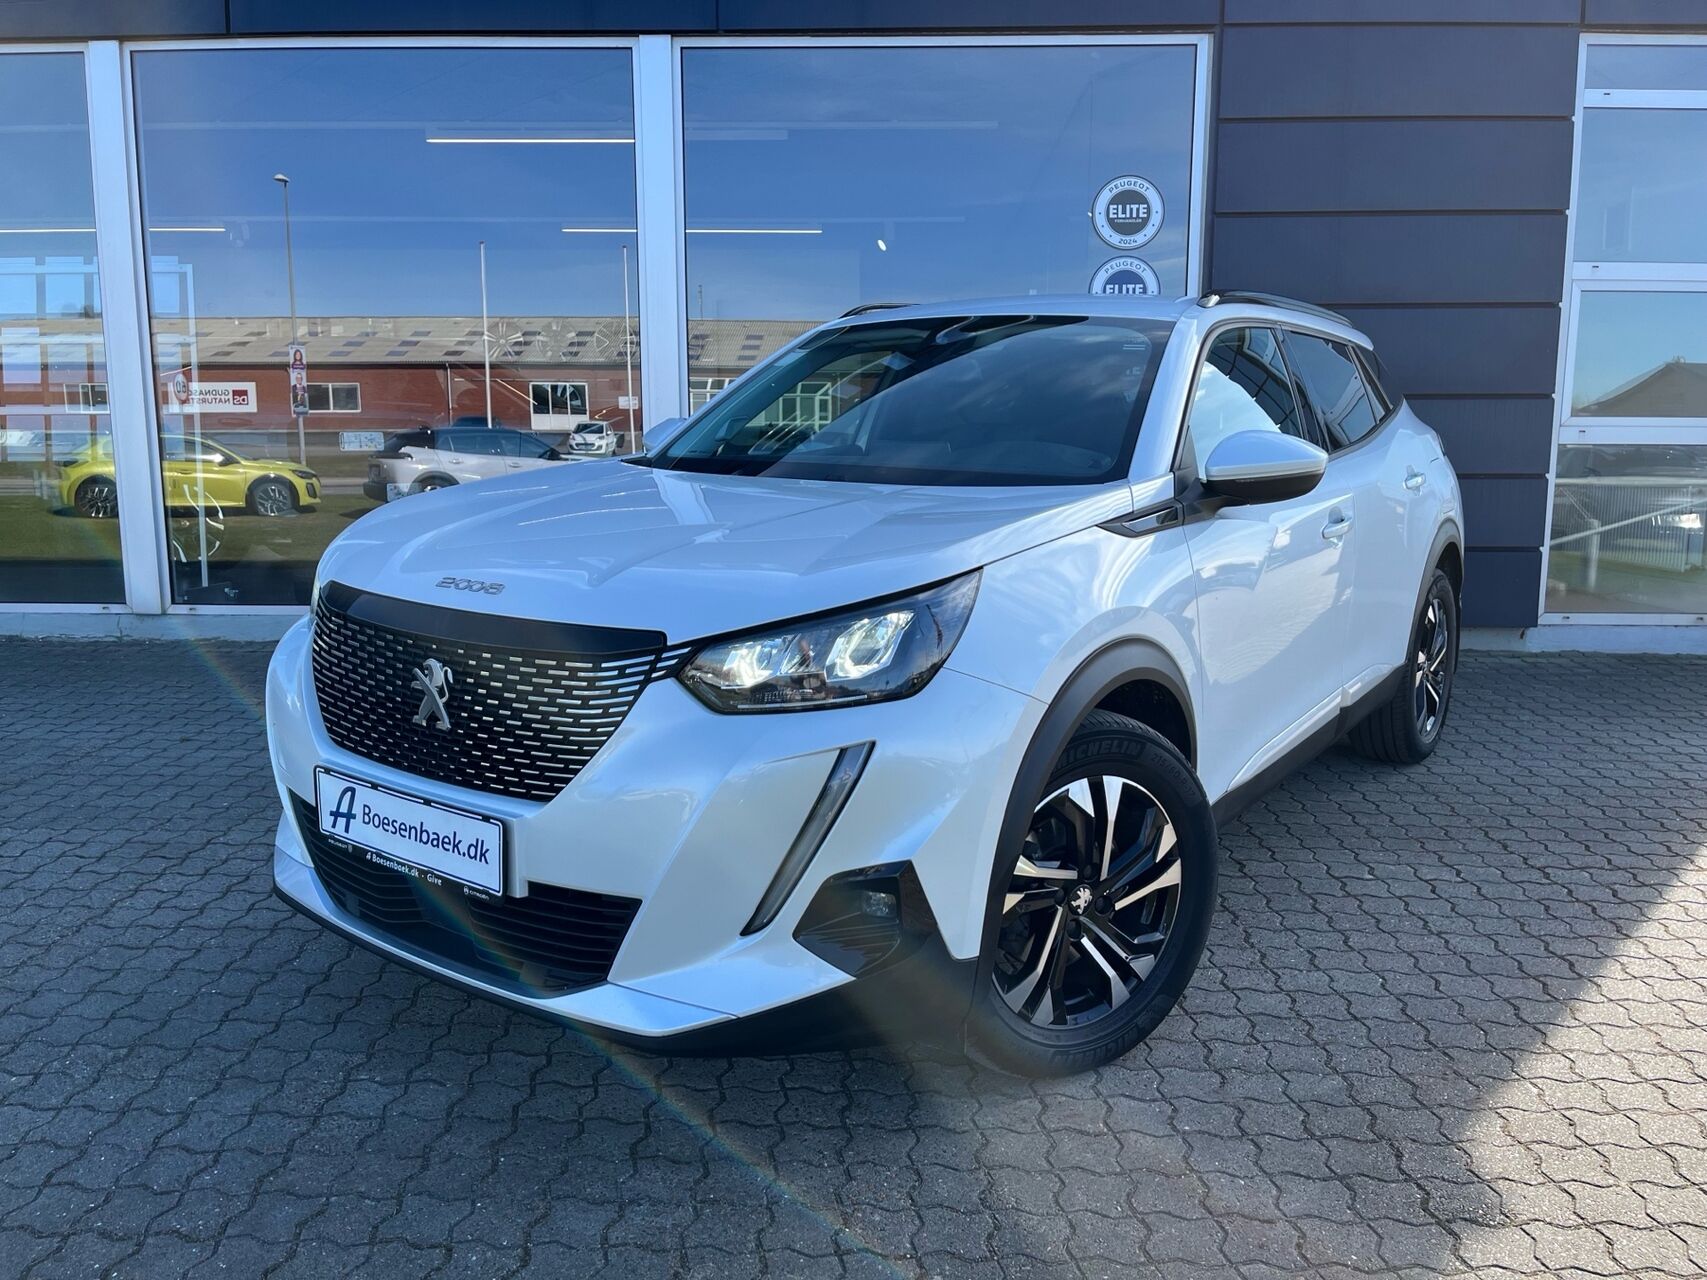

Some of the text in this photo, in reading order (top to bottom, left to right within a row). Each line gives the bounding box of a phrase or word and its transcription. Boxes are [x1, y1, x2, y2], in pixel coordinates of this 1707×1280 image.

[1108, 180, 1150, 194] PEUGEOT
[1109, 204, 1148, 219] ELITE
[1104, 261, 1147, 274] PEUGEOT
[435, 576, 506, 595] 2008
[361, 803, 491, 866] Boesenbaek.dk
[372, 854, 420, 879] Boesenbaek.dk
[426, 873, 443, 887] Give
